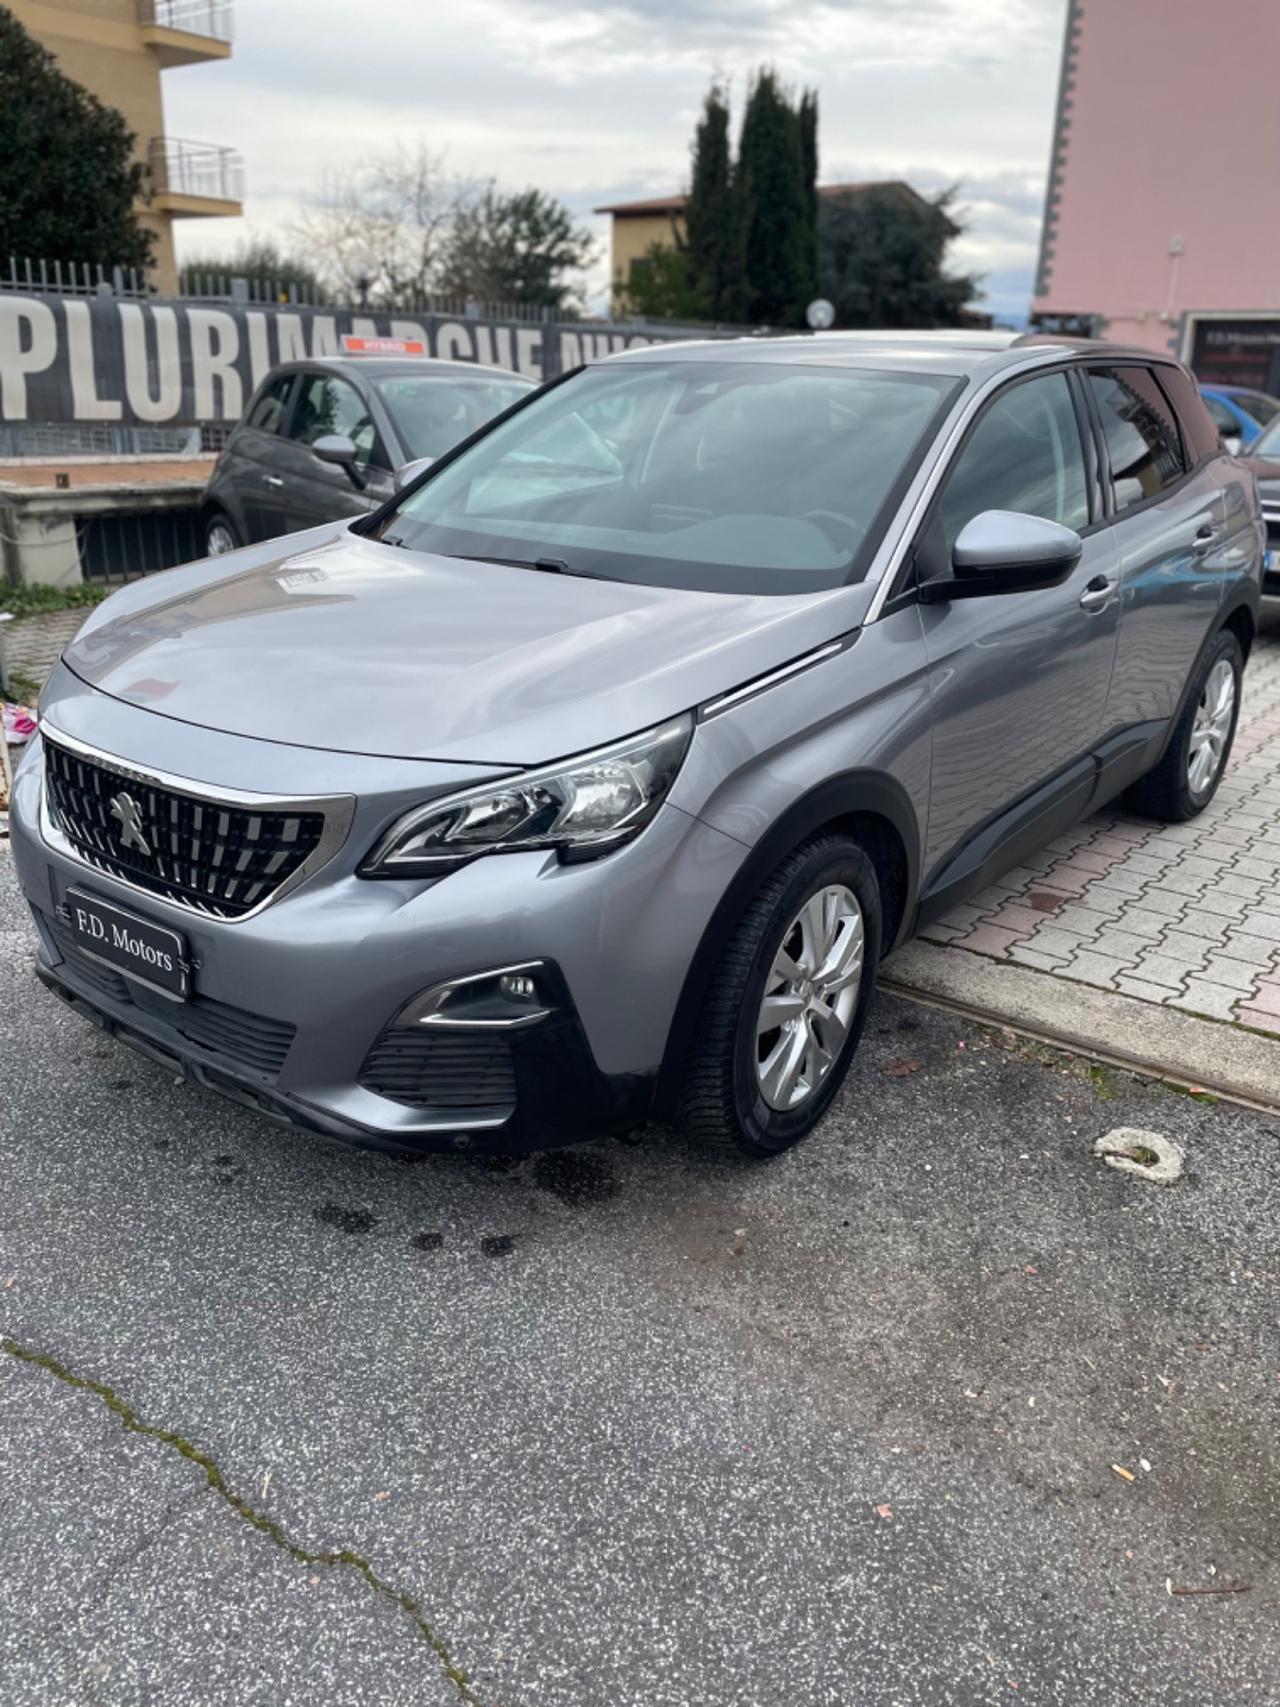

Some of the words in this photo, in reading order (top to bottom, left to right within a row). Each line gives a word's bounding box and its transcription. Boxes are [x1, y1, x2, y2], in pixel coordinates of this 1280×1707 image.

[0, 296, 543, 421] PLURIMCHE
[76, 907, 109, 943] F.D.
[111, 923, 173, 972] Motors
